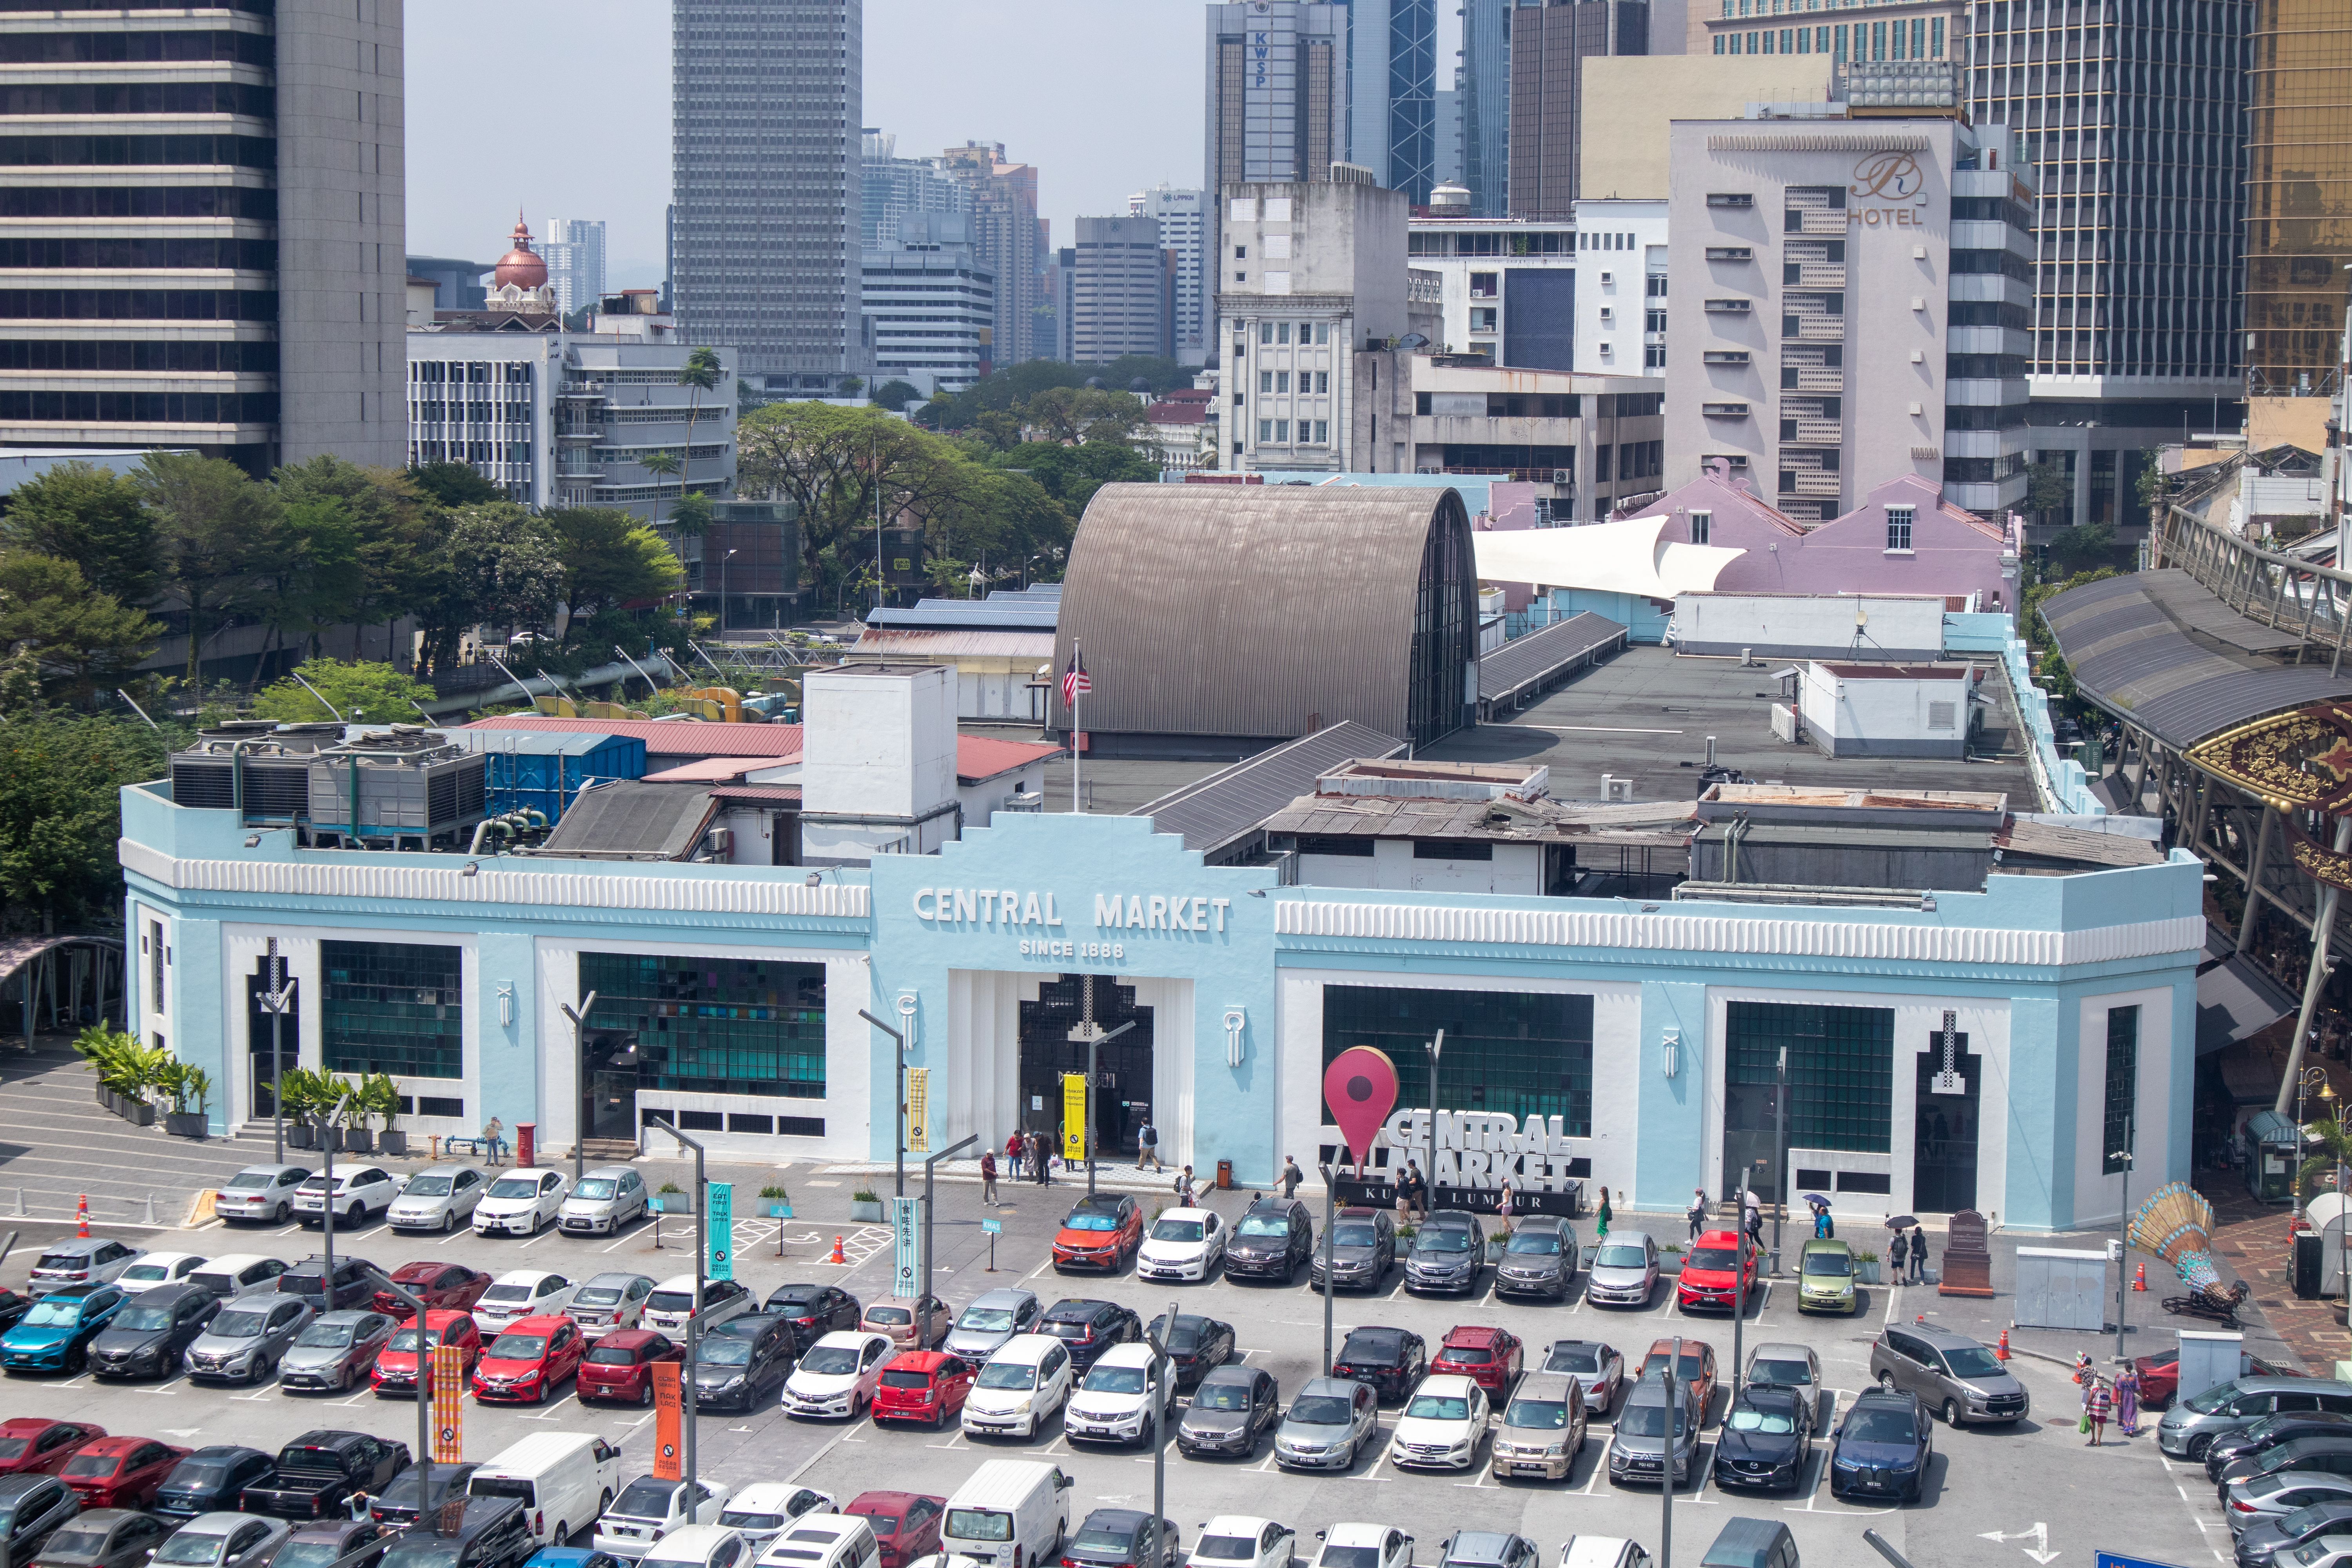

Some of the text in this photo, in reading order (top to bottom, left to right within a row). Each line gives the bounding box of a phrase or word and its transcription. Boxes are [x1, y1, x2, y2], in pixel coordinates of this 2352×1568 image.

[1255, 33, 1268, 87] KWSP
[1847, 209, 1923, 225] HOTEL
[913, 888, 1230, 932] CENTRAL MARKET
[1020, 940, 1123, 958] SINCE 1888
[1386, 1108, 1572, 1156] CENTRAL
[1384, 1147, 1572, 1192] MARKET
[1452, 1192, 1541, 1208] LUMUR
[902, 1205, 911, 1248] 食咗先讲
[984, 1221, 1000, 1230] KHAS
